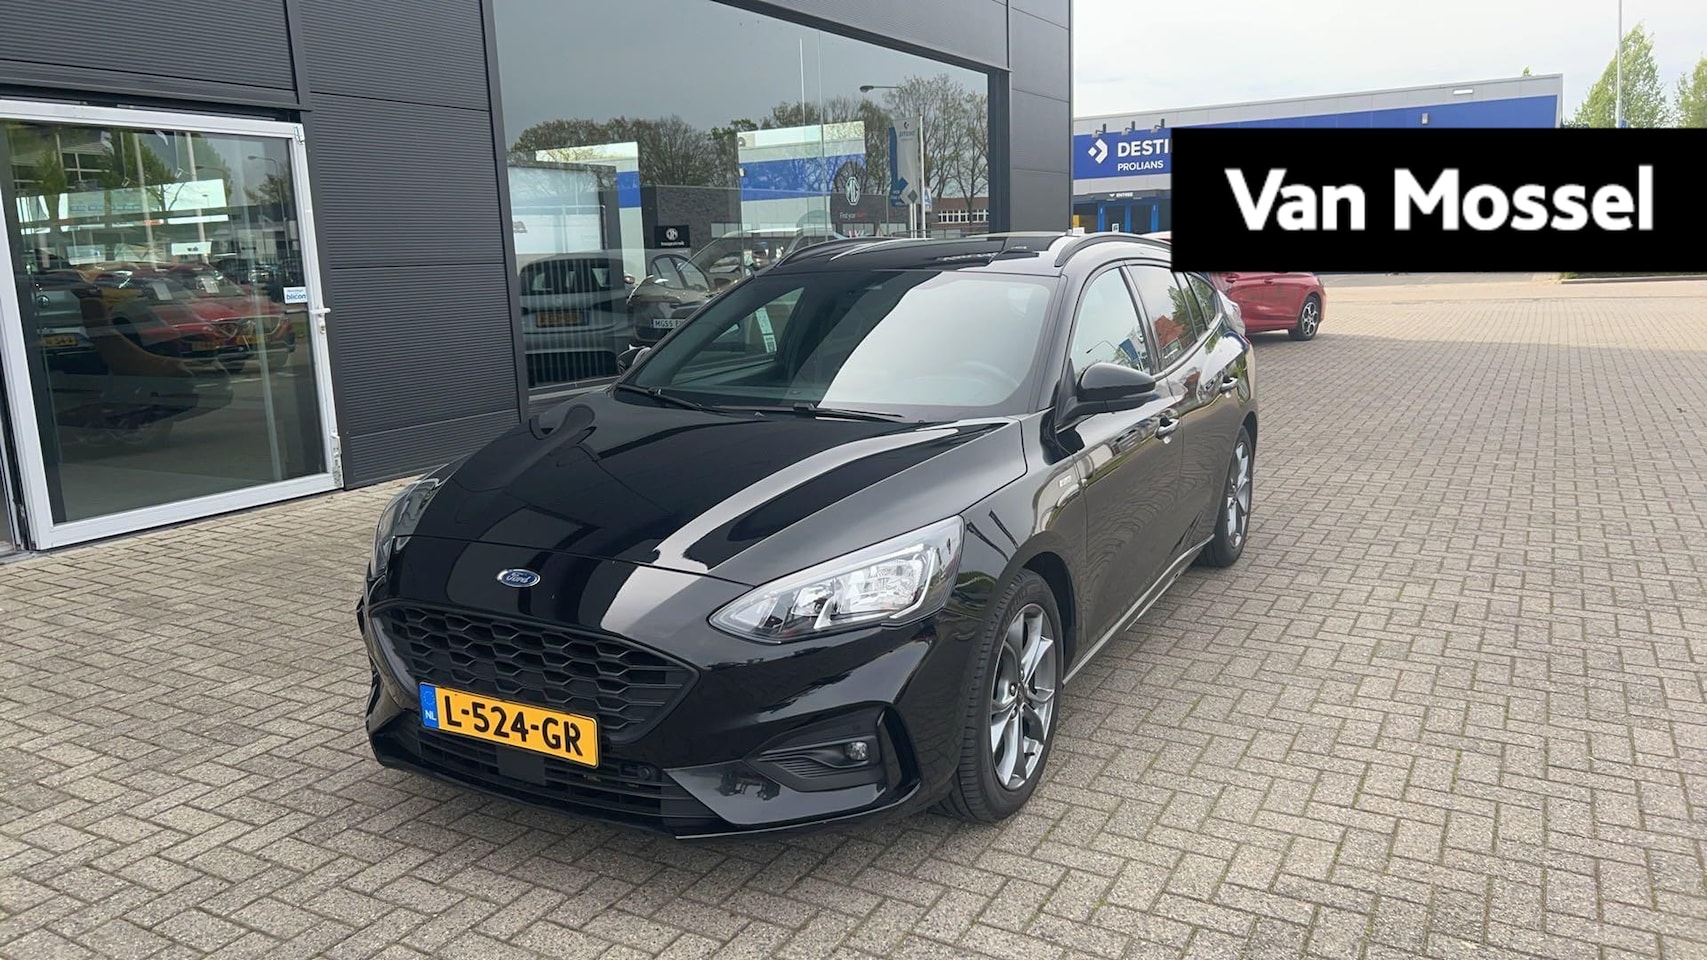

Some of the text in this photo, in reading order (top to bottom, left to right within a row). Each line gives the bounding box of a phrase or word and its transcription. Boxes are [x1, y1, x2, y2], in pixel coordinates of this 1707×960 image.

[1117, 139, 1169, 157] DESTI
[1117, 160, 1164, 171] PROLIANS
[506, 572, 532, 583] Ford
[425, 710, 437, 721] NL
[444, 695, 583, 757] L-524-GR
